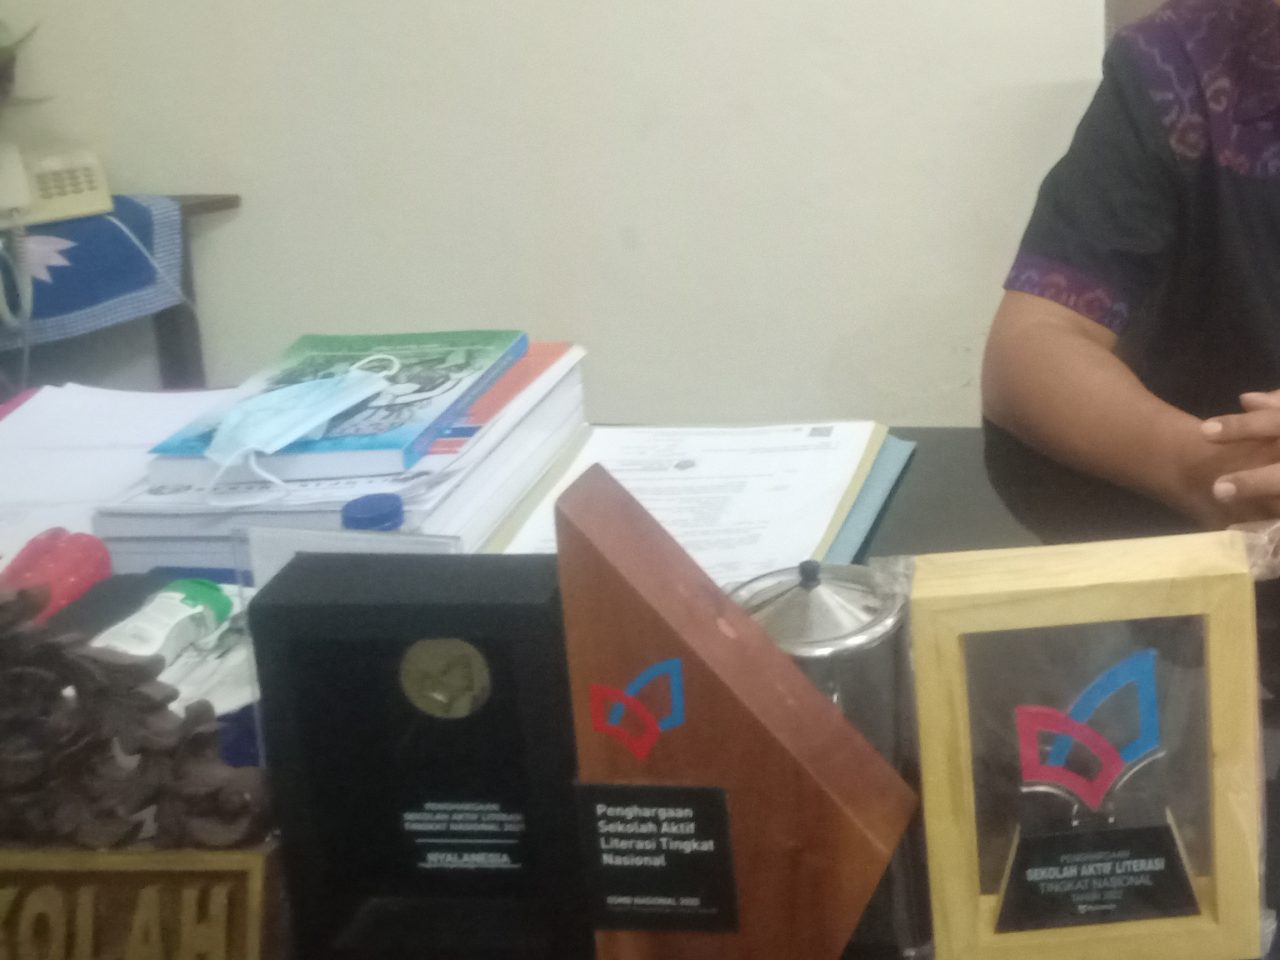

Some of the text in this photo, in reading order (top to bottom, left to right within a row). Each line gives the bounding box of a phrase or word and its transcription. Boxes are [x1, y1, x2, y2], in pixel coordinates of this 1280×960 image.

[596, 804, 694, 820] Penghargaan
[598, 820, 696, 834] Sekolah Aktif
[600, 837, 714, 854] Literasi Tingkat
[602, 853, 666, 866] Nasional
[1025, 857, 1166, 882] SEKOLAH AKTIF LITERASI
[1039, 874, 1153, 894] TINGKAT NASIONAL
